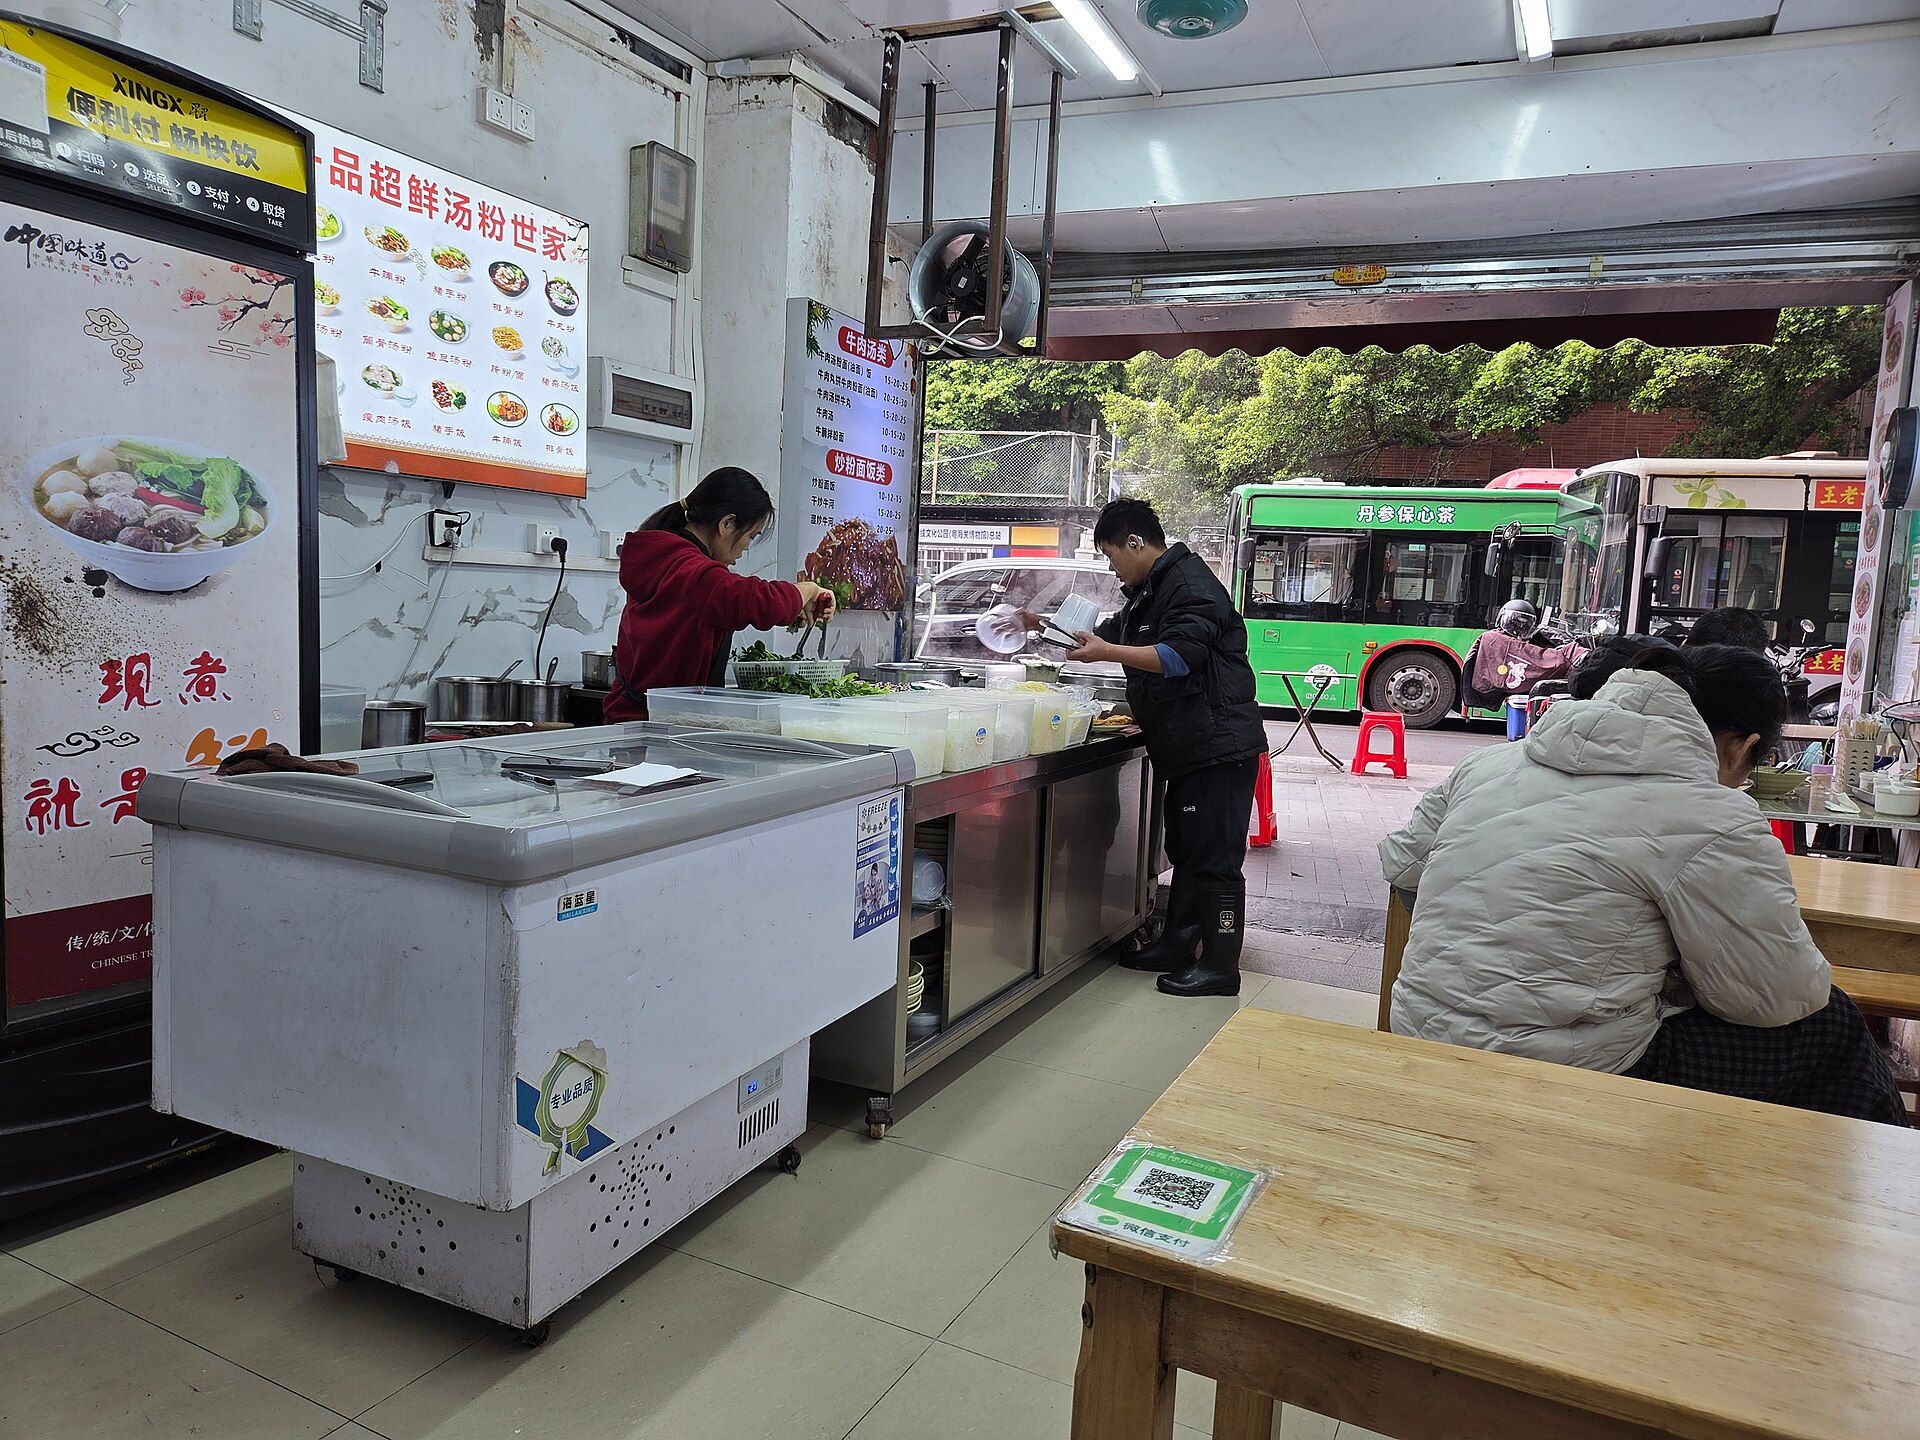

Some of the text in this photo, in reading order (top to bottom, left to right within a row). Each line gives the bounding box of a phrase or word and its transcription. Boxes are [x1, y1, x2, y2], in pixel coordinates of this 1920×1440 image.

[112, 72, 185, 115] XINGX
[66, 86, 260, 172] 便利付 畅快饮
[77, 147, 106, 168] 扫码
[142, 167, 170, 187] 选品
[204, 185, 230, 204] 支付
[262, 202, 286, 220] 取货
[83, 164, 105, 176] SCAN
[212, 202, 226, 211] PAY
[267, 217, 283, 229] TAKE
[315, 146, 567, 262] 品超鲜汤粉世家
[492, 303, 524, 319] 排骨粉
[845, 330, 887, 365] 牛肉汤类
[884, 375, 909, 392] 15-20-25
[883, 392, 908, 408] 20-25-30
[362, 411, 412, 430] 瘦肉汤饭
[816, 406, 906, 442] 牛肉汤 10-15-20
[882, 409, 907, 425] 15-20-25
[881, 443, 905, 458] 10-15-20
[834, 452, 886, 483] 炒粉面饭类
[811, 477, 902, 503] 炒粉面饭 10-12-15
[1820, 485, 1864, 505] 王老
[811, 495, 901, 520] 干炒牛河 15-20-25
[1357, 504, 1456, 524] 丹参保心茶
[876, 524, 898, 535] 20-25-
[1809, 652, 1844, 672] 王老
[98, 651, 232, 711] 现煮
[867, 801, 888, 817] FREEZE
[562, 890, 595, 910] 海蓝星
[91, 952, 138, 970] CHINESE
[550, 1076, 593, 1109] 专业品质
[1122, 1221, 1191, 1248] 微信支付
